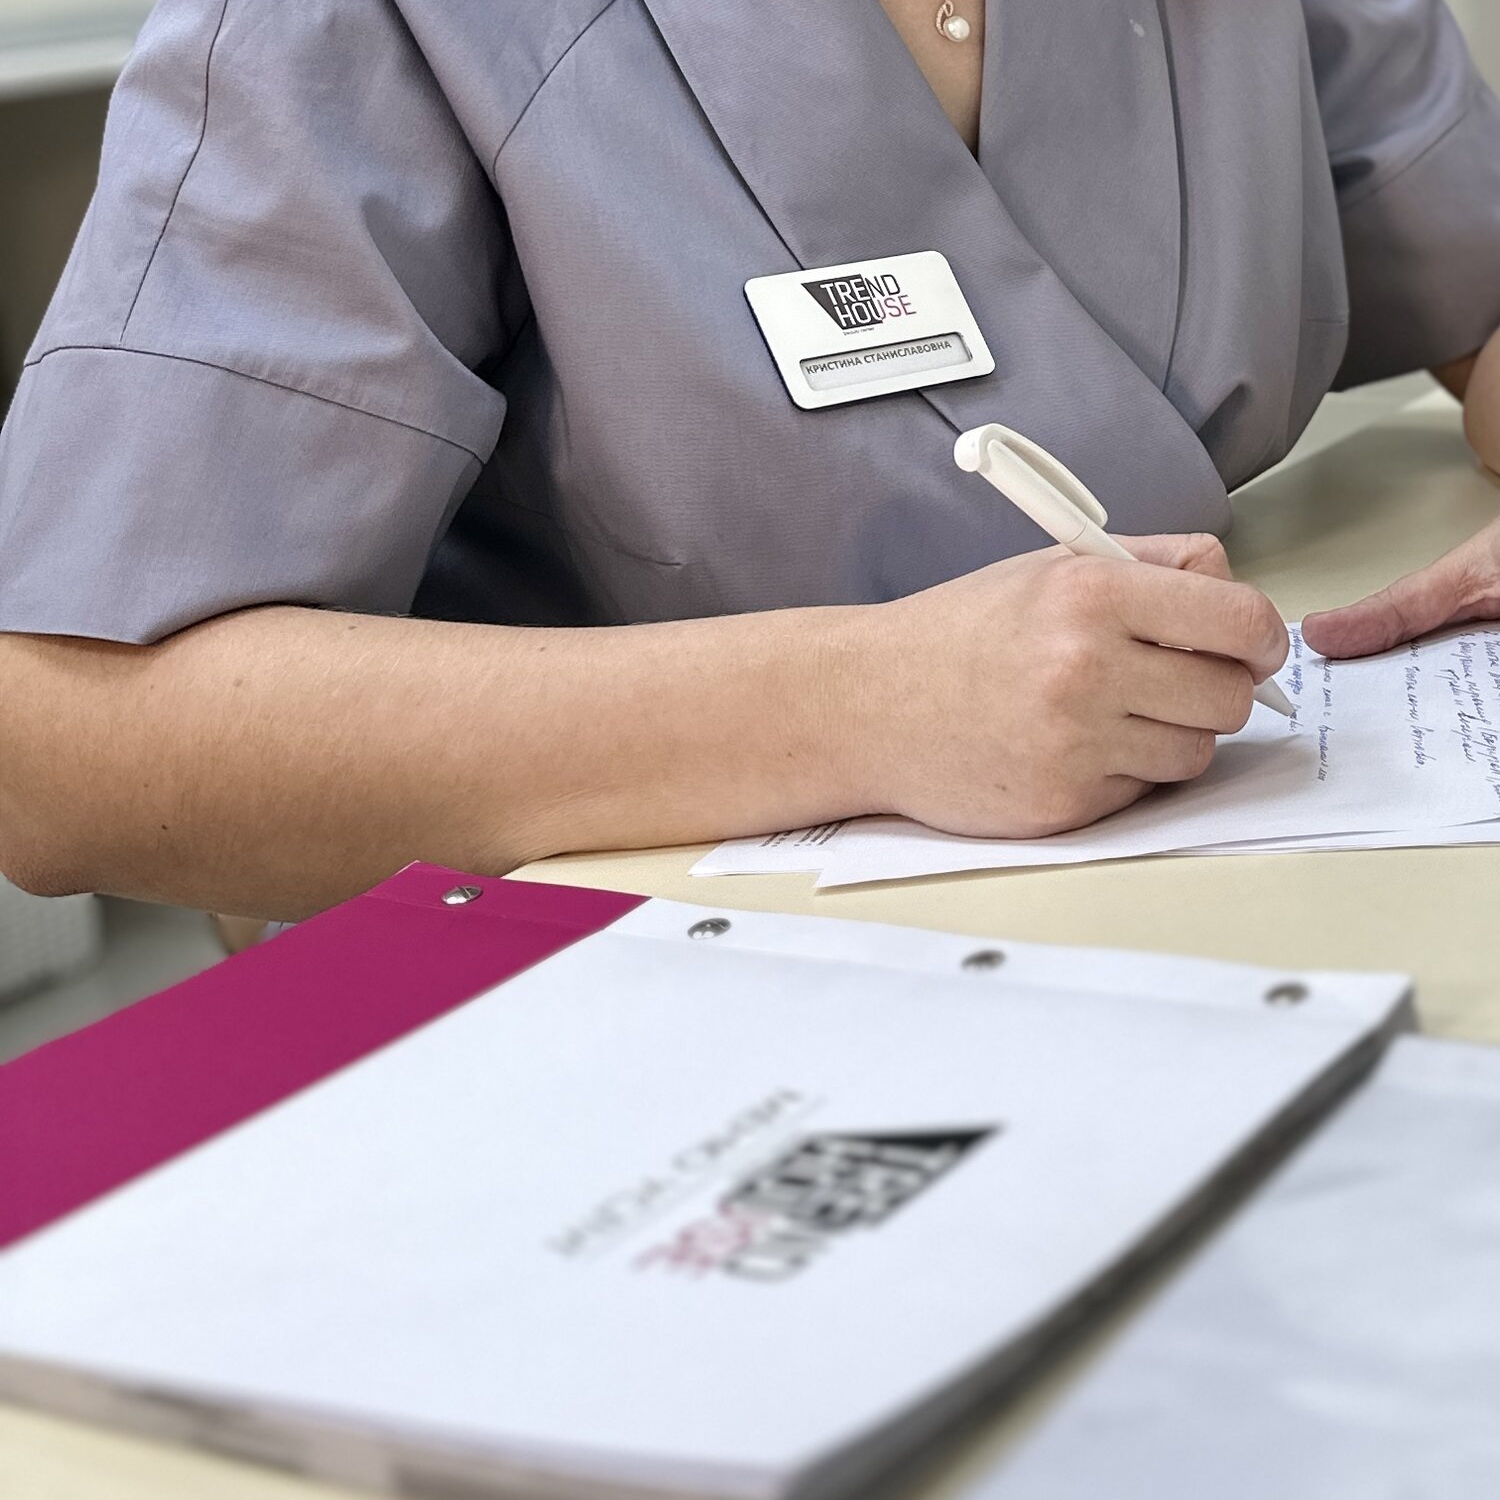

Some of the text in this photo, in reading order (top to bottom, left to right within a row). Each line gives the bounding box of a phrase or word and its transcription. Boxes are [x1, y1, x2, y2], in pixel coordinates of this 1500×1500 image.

[820, 274, 901, 305] TREND
[834, 294, 917, 327] HOUSE
[805, 340, 952, 375] КРИСТИНА СТАНИСЛАВОВНА
